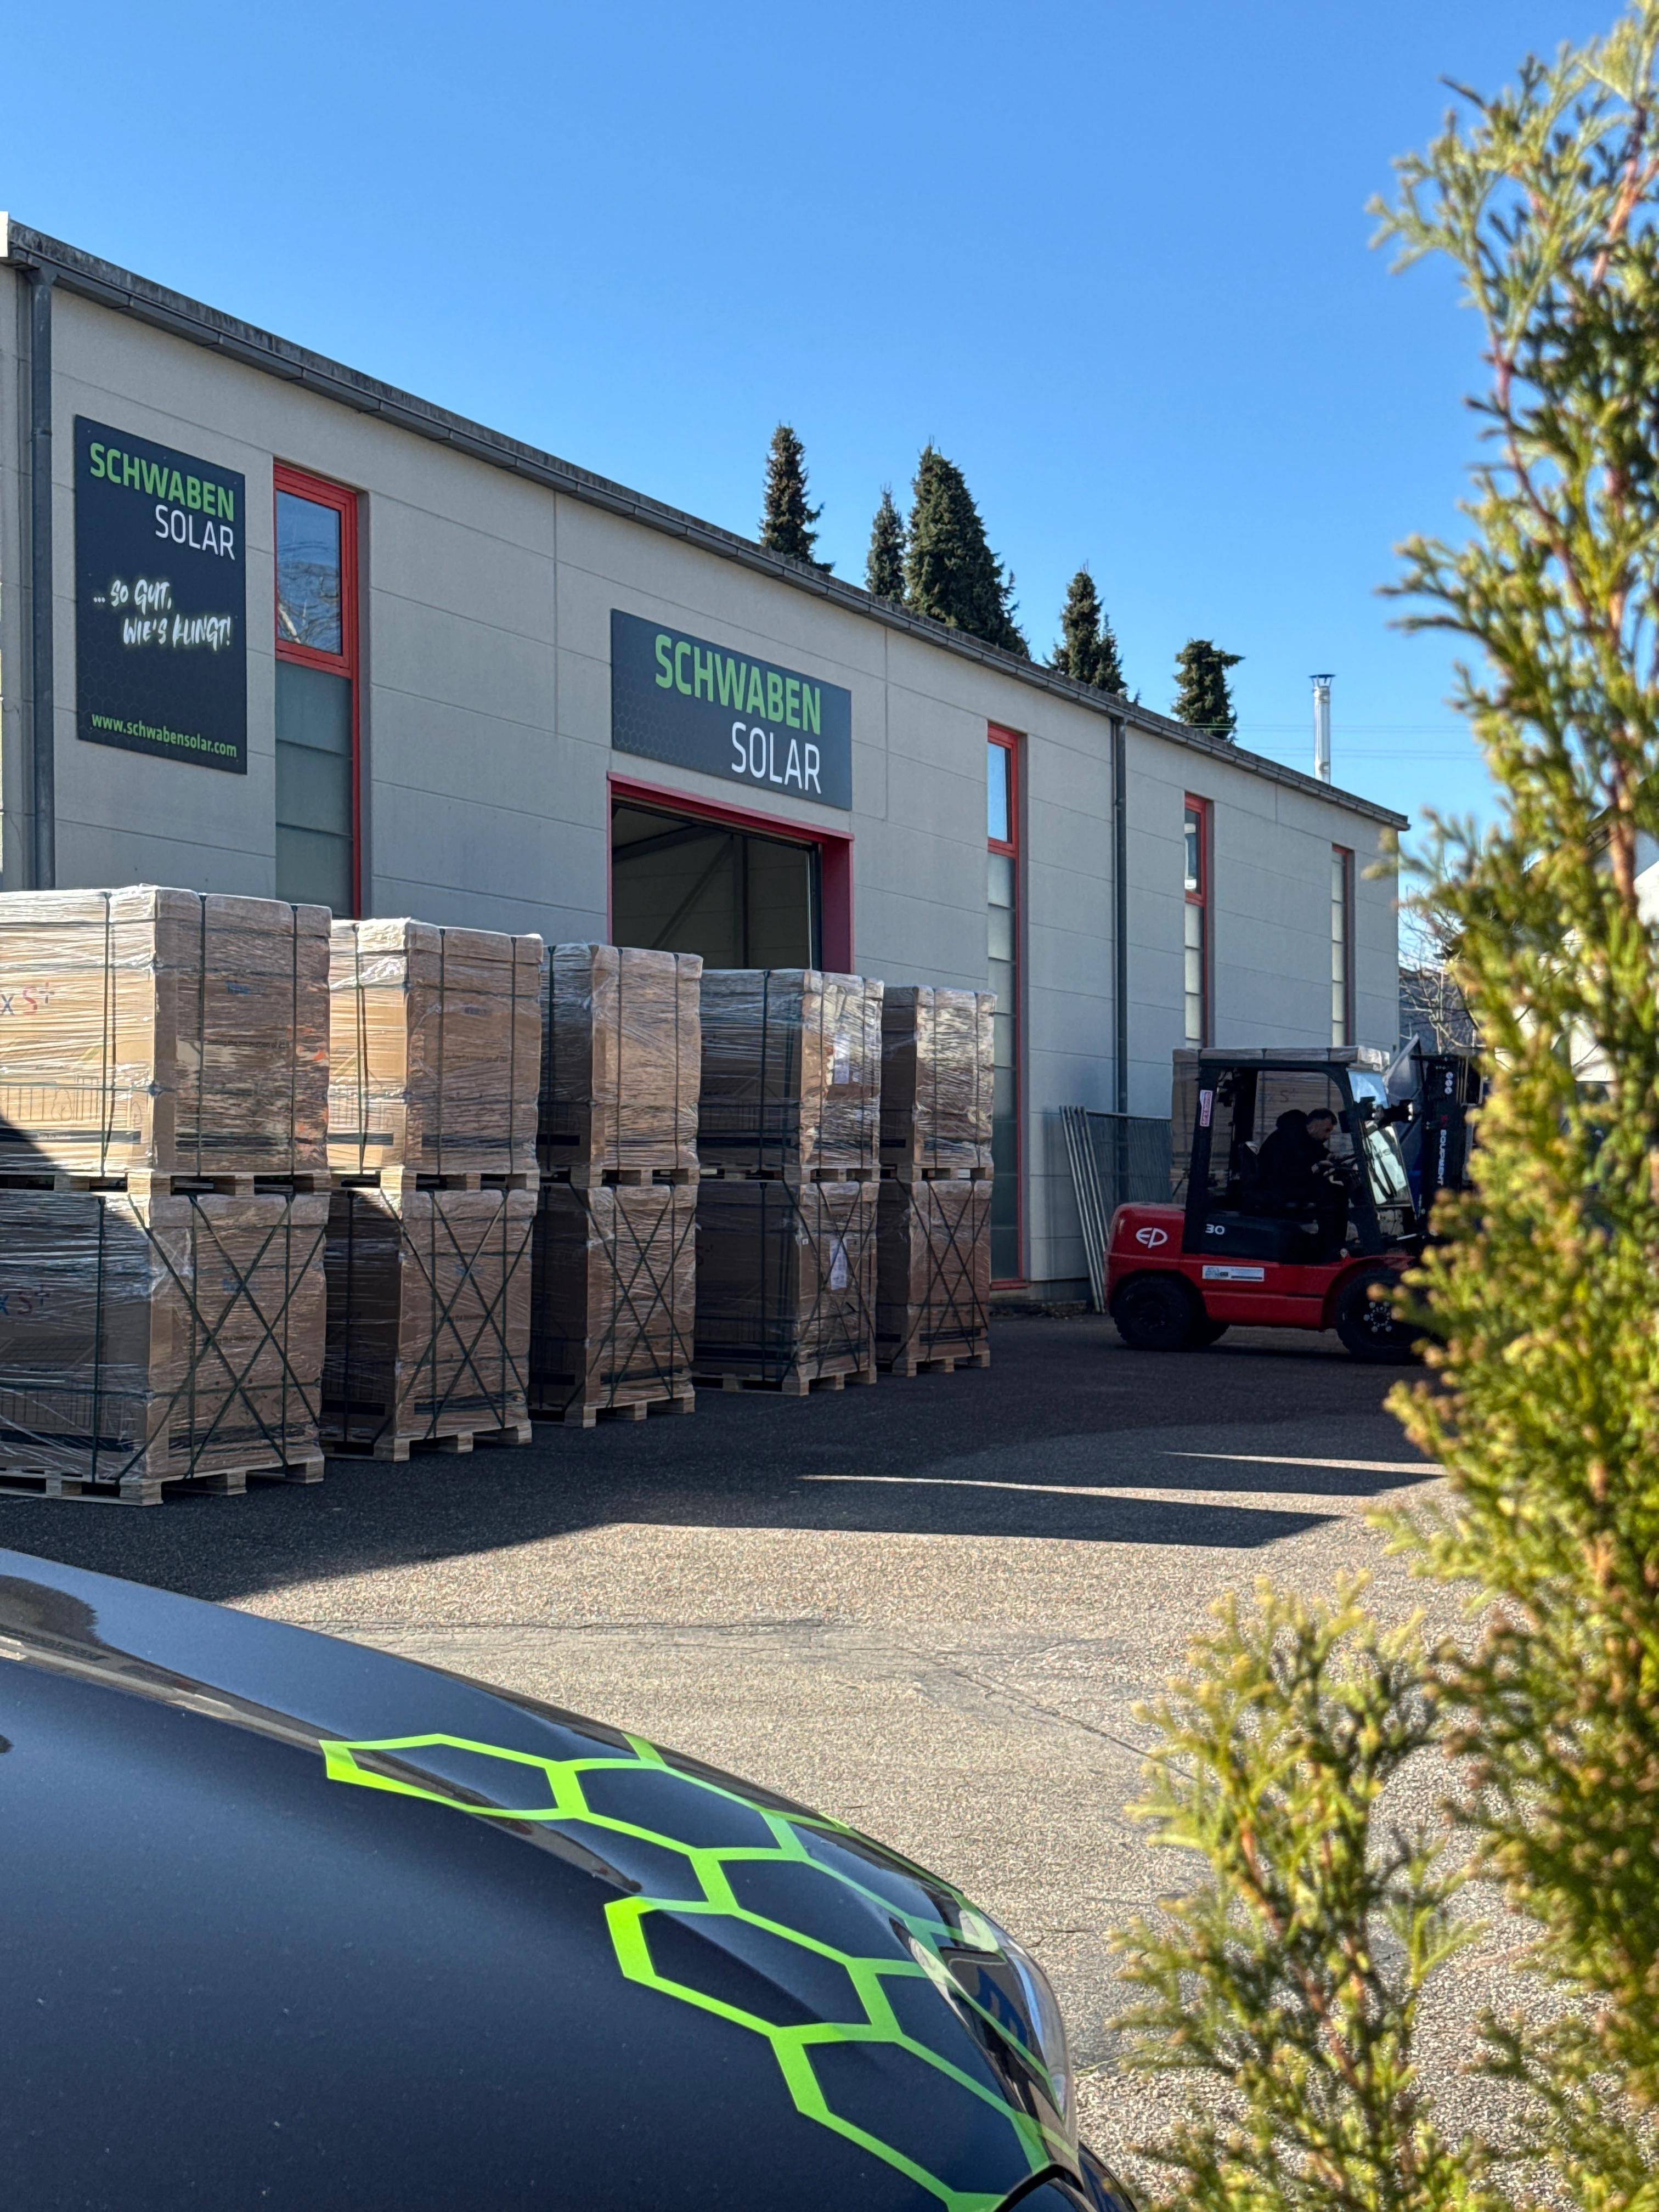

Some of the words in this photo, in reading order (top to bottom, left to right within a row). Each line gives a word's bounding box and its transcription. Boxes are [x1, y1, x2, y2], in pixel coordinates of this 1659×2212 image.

[90, 442, 234, 521] SCHWABEN
[155, 504, 235, 560] SOLAR
[656, 635, 820, 735] SCHWABEN
[92, 713, 237, 758] www.schwabensolar.com
[731, 721, 822, 794] SOLAR
[1136, 1227, 1168, 1249] EP
[1205, 1223, 1225, 1235] 30
